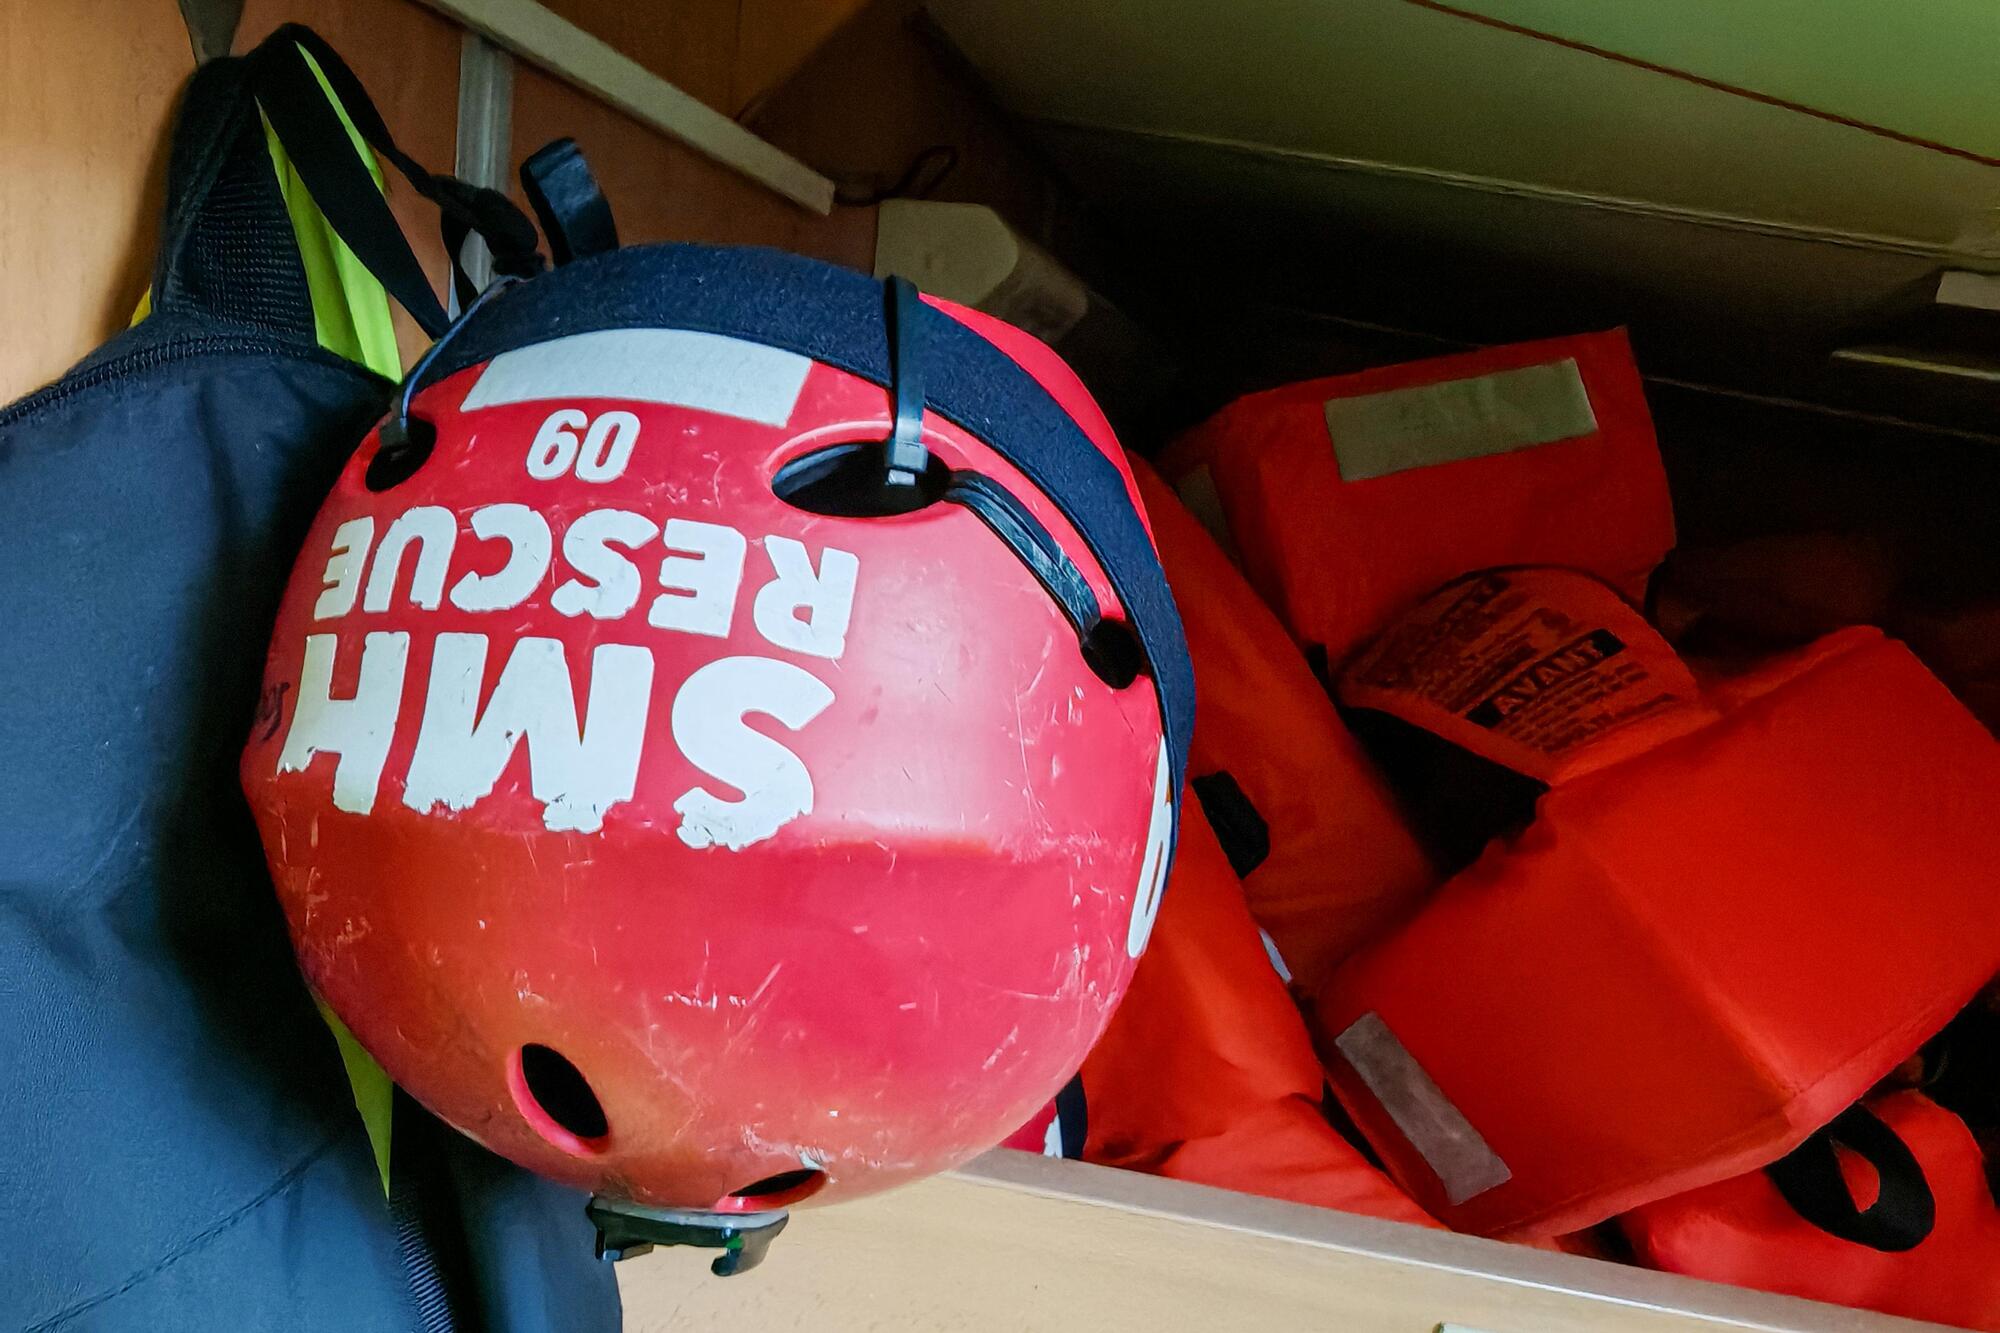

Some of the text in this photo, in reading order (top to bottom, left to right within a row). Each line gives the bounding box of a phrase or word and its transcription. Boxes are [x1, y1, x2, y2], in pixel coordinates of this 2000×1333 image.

[527, 409, 641, 484] 09
[314, 503, 860, 658] RESCUE
[1491, 639, 1606, 716] AVANT
[276, 632, 836, 851] SMH
